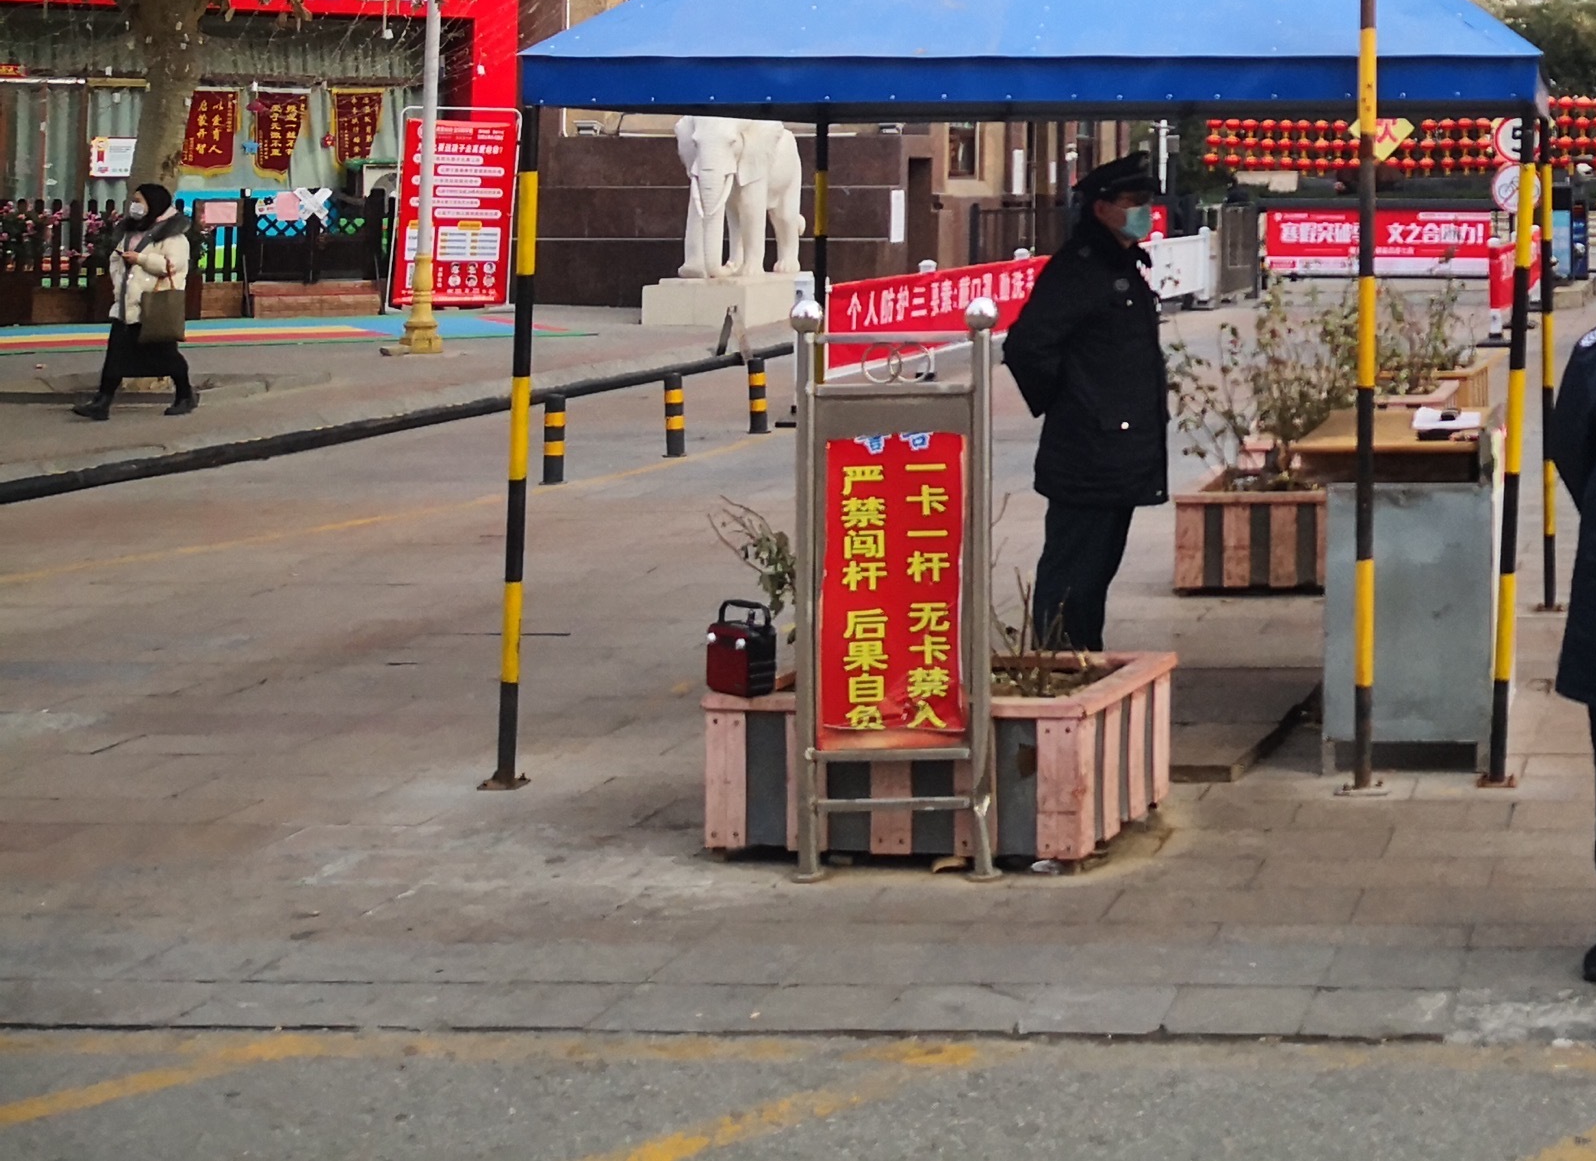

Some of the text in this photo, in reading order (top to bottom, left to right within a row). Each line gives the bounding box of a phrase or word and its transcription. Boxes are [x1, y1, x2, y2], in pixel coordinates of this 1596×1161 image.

[840, 465, 889, 731] 严禁闯杆 后果自负
[905, 461, 952, 730] 一卡一杆 无卡禁入
